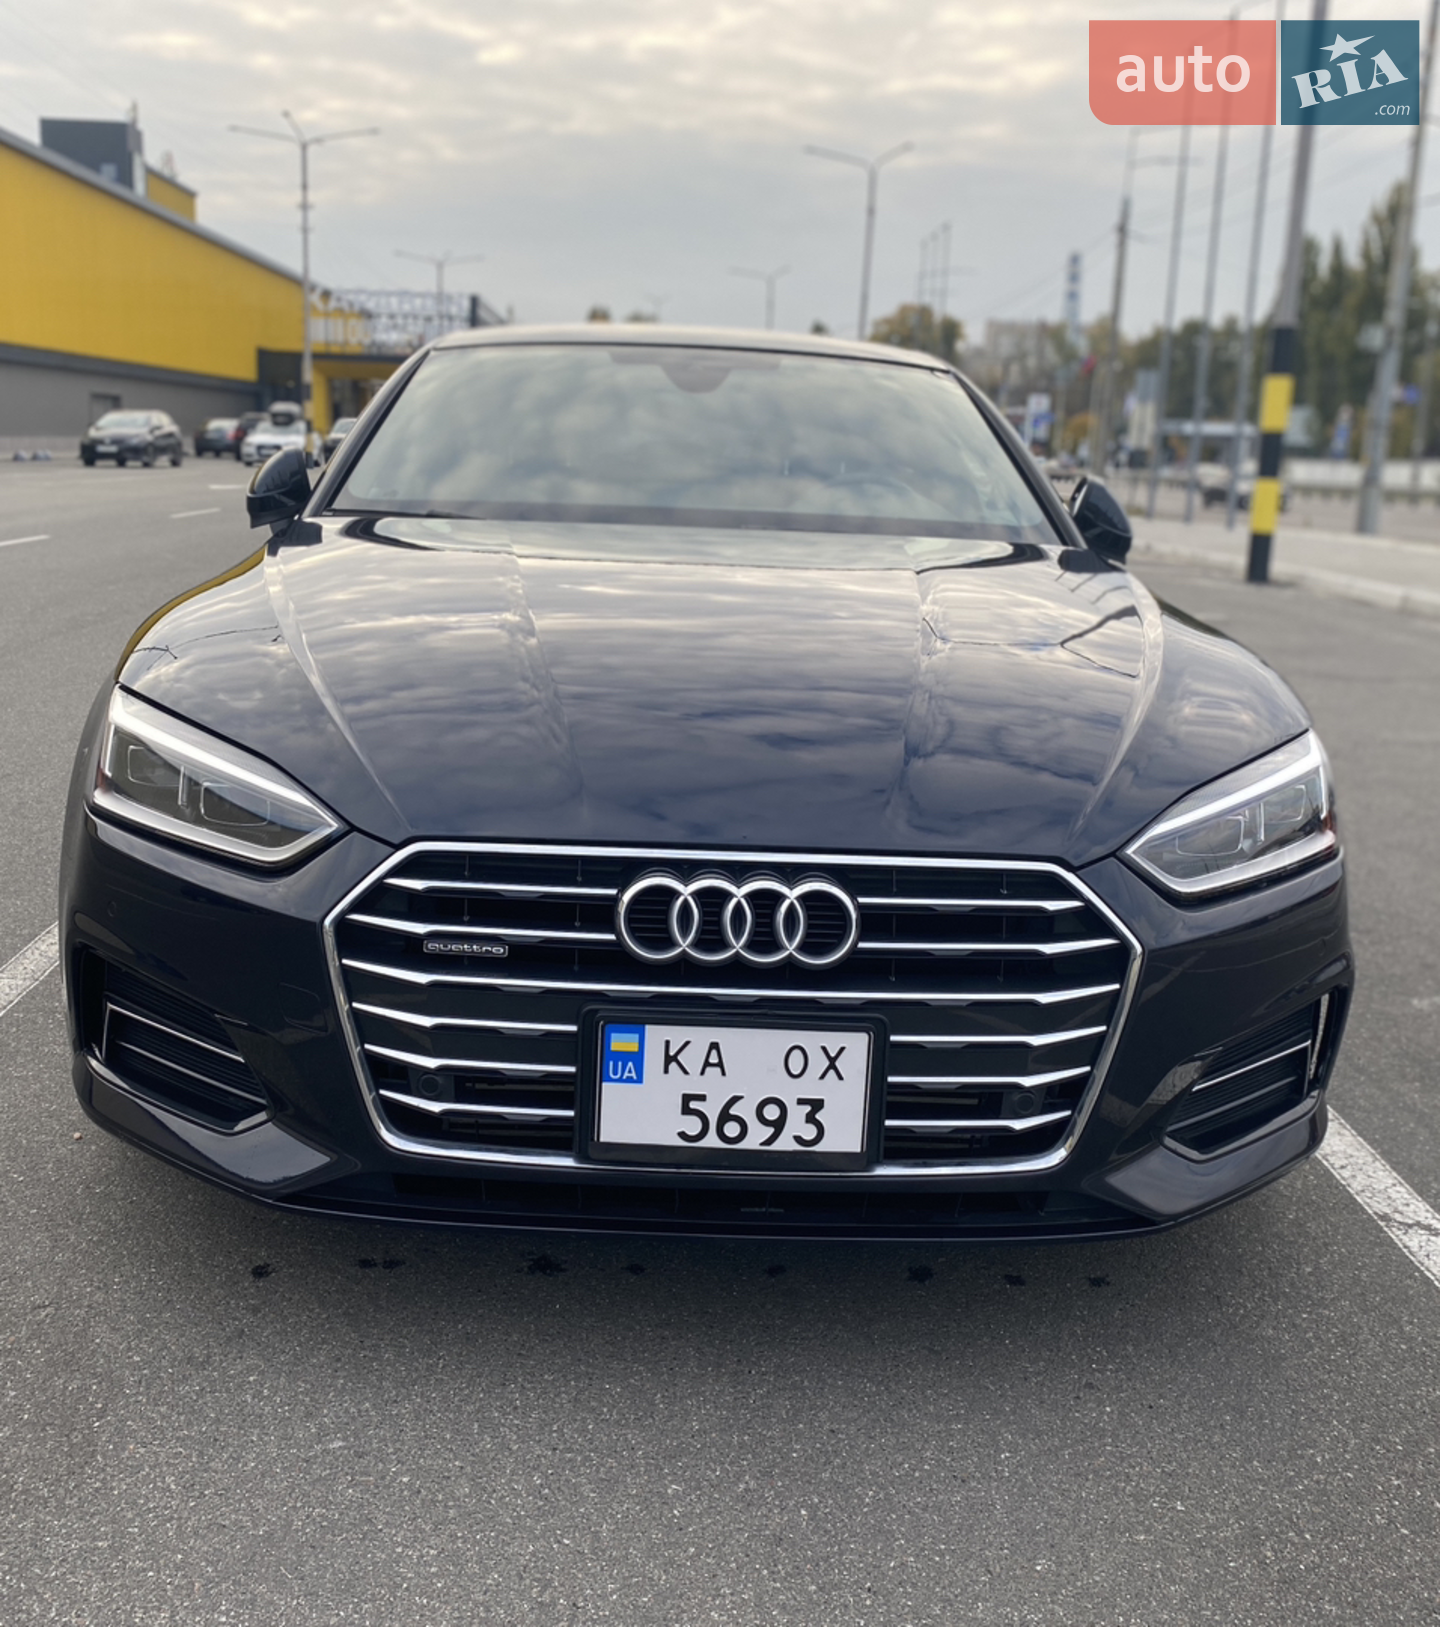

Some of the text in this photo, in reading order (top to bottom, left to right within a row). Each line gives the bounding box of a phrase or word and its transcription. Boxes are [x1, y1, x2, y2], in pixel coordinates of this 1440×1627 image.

[427, 942, 504, 954] quattro
[608, 1061, 637, 1080] UA
[663, 1039, 727, 1077] KA
[676, 1093, 826, 1148] 5693
